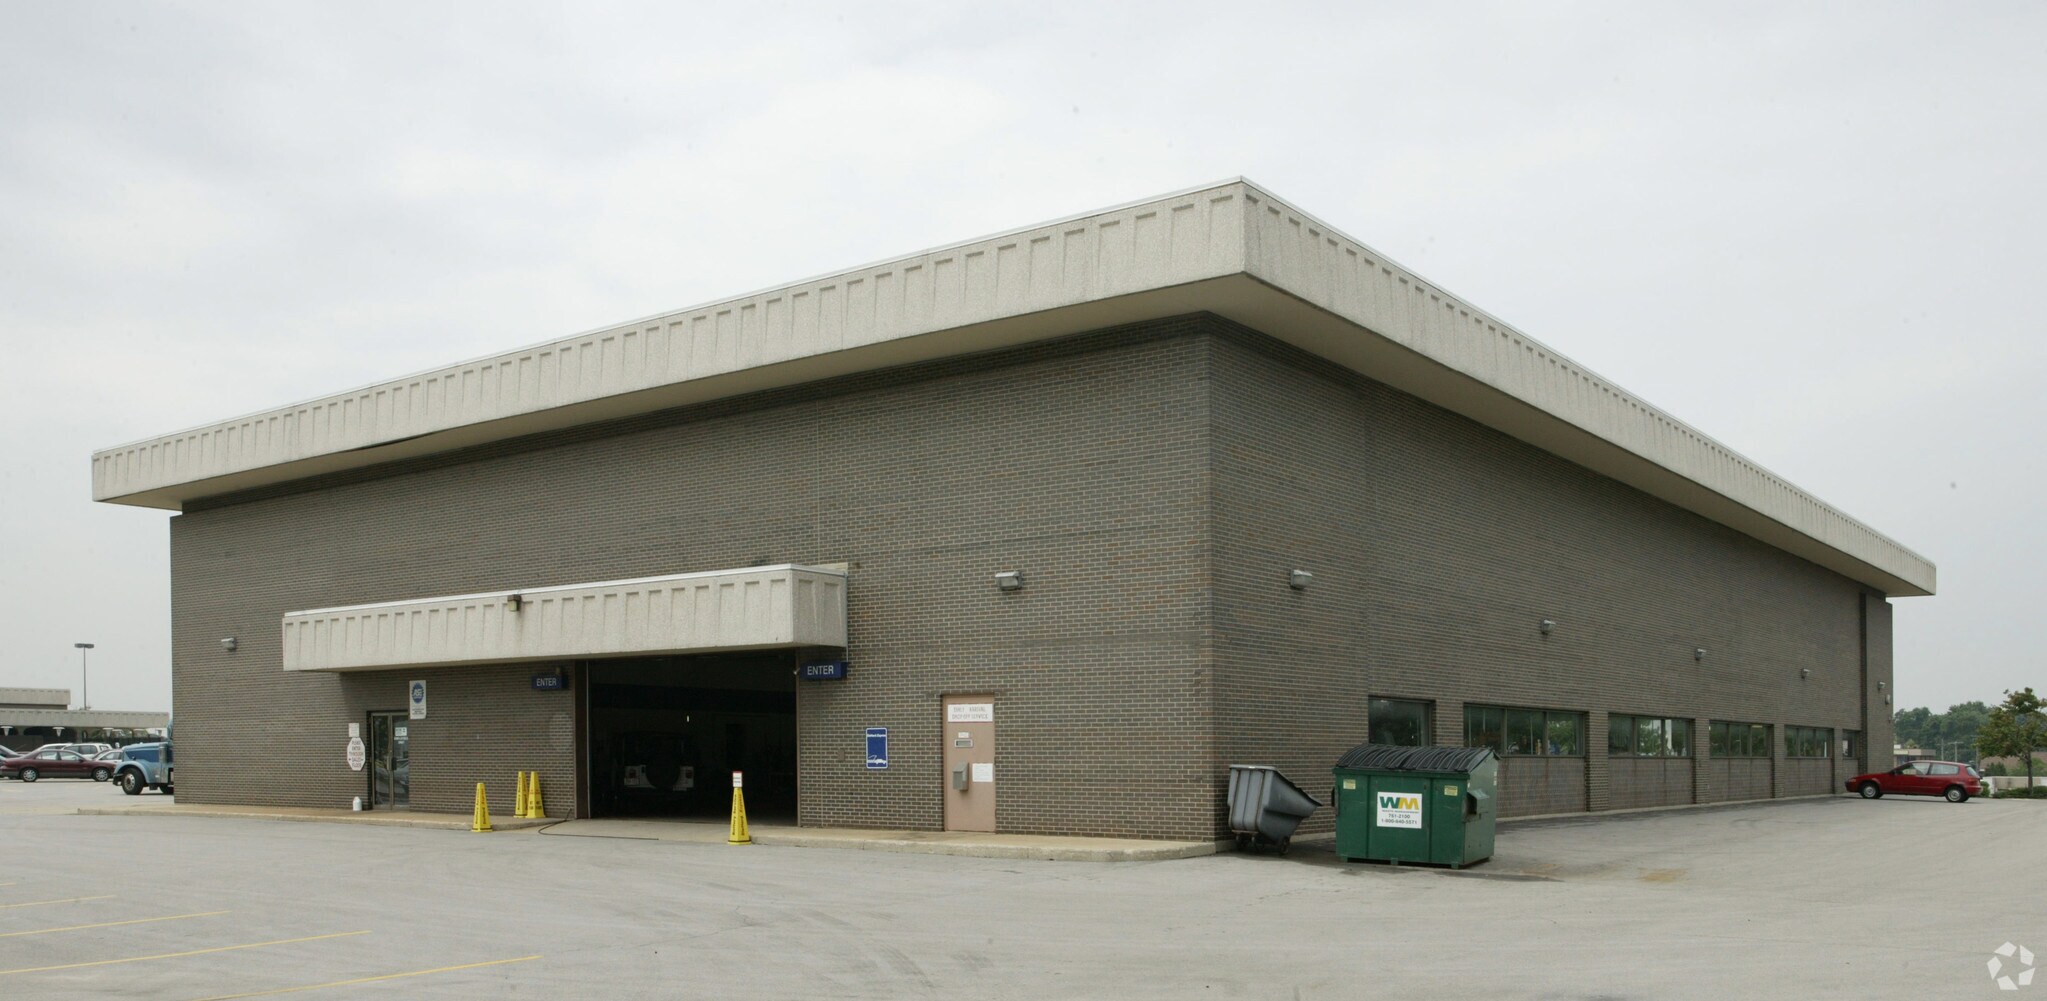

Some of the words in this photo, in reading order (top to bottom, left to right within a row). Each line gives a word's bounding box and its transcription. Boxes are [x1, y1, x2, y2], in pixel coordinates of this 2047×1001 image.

[807, 665, 834, 675] ENTER
[536, 677, 557, 687] ENTER
[1379, 796, 1419, 810] WM
